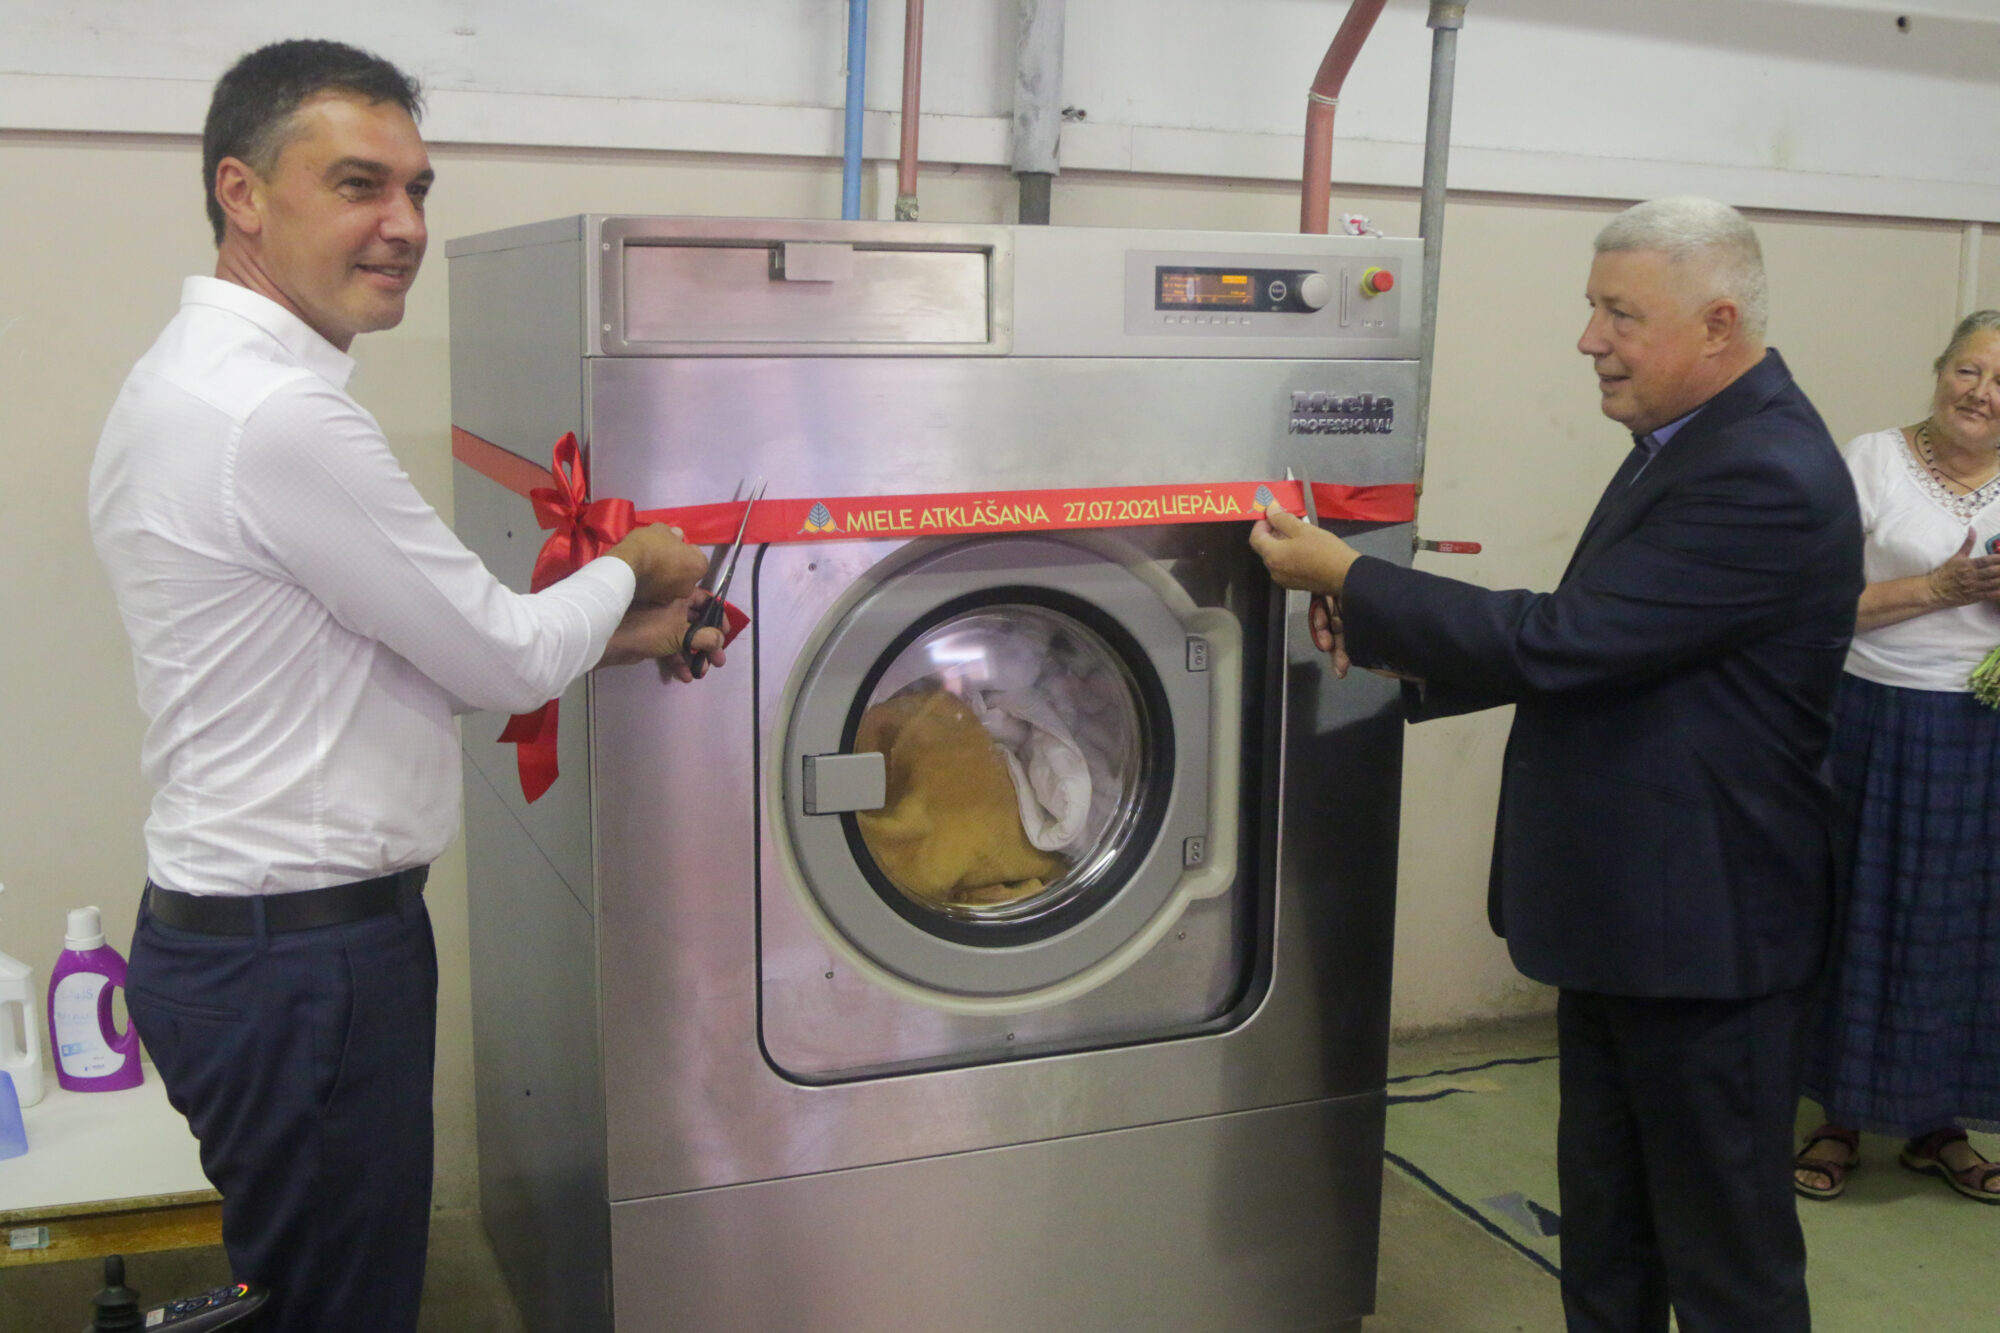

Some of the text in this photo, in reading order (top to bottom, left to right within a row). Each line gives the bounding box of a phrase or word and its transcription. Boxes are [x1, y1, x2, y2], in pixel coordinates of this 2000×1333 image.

[1290, 391, 1394, 413] Miele
[1289, 418, 1393, 434] PROFESSIONAL
[846, 490, 1242, 532] MIELE ATKLĀŠANA 27.07.2021 LIEPĀJA
